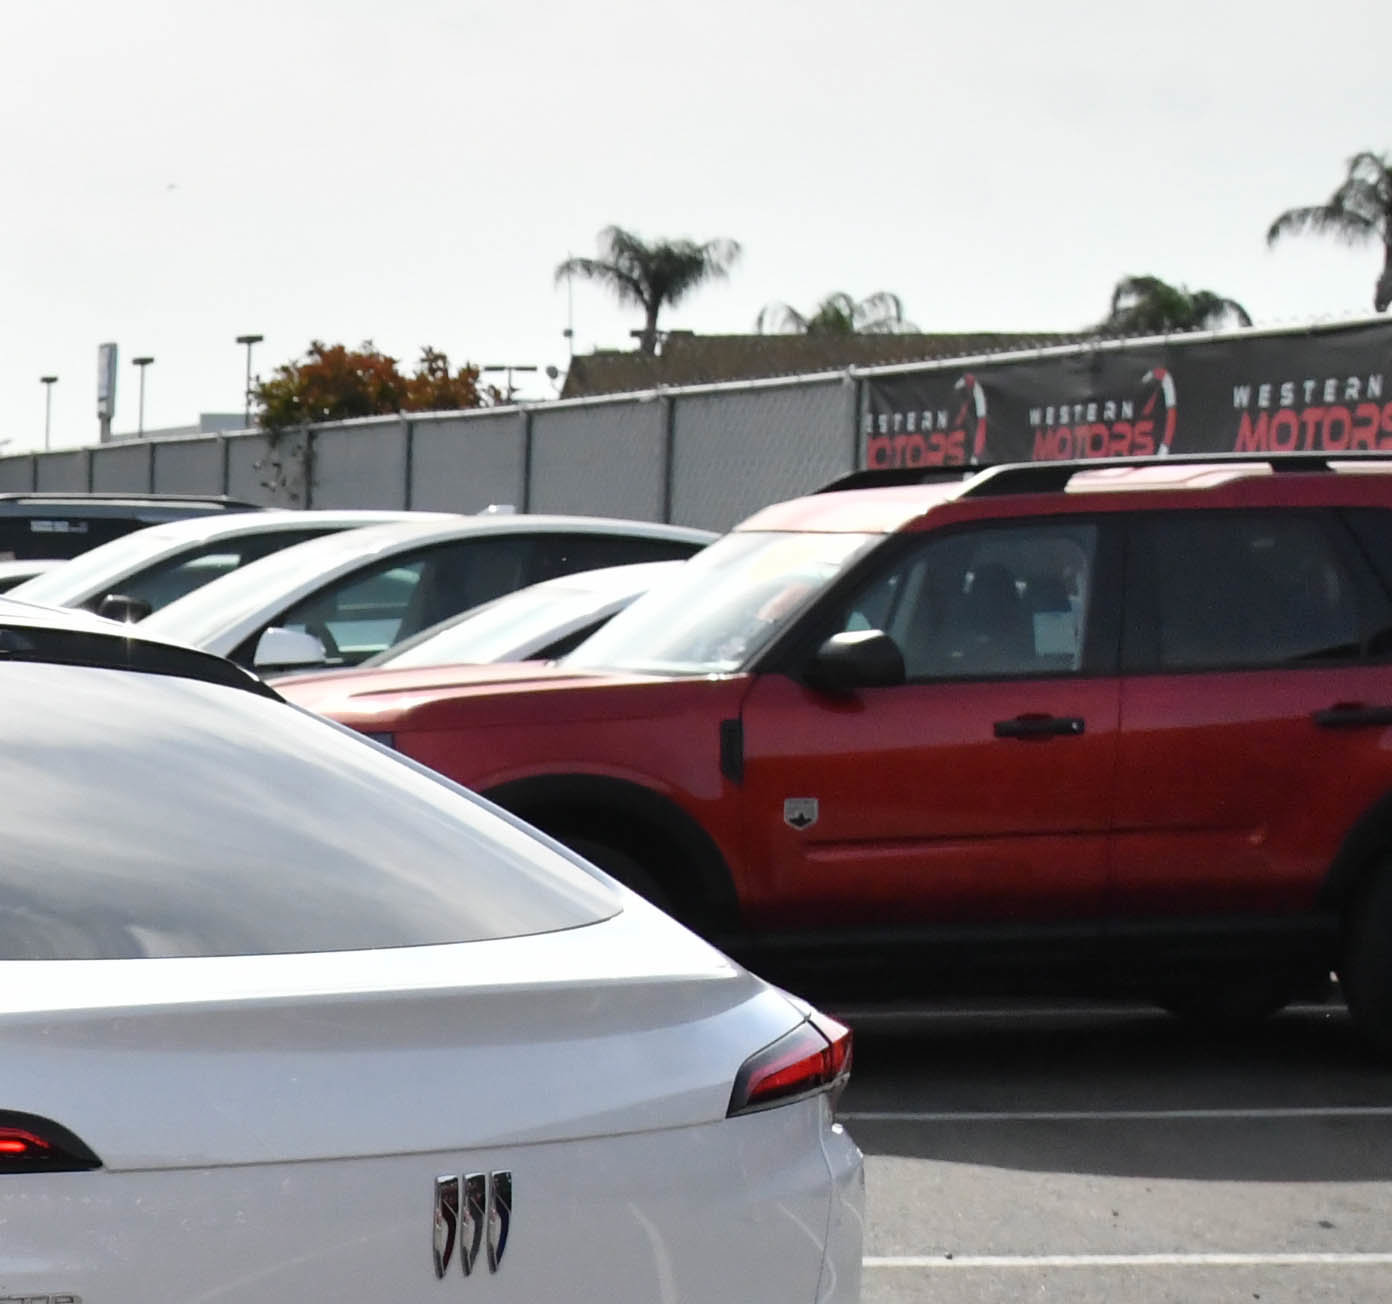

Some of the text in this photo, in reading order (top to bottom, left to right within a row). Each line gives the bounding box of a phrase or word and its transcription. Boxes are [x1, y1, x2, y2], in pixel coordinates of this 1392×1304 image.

[1233, 374, 1384, 408] WESTERN
[866, 411, 949, 433] ESTERN
[1029, 400, 1134, 425] WESTERN
[867, 431, 966, 469] OTORS
[1032, 420, 1155, 459] MOTORS
